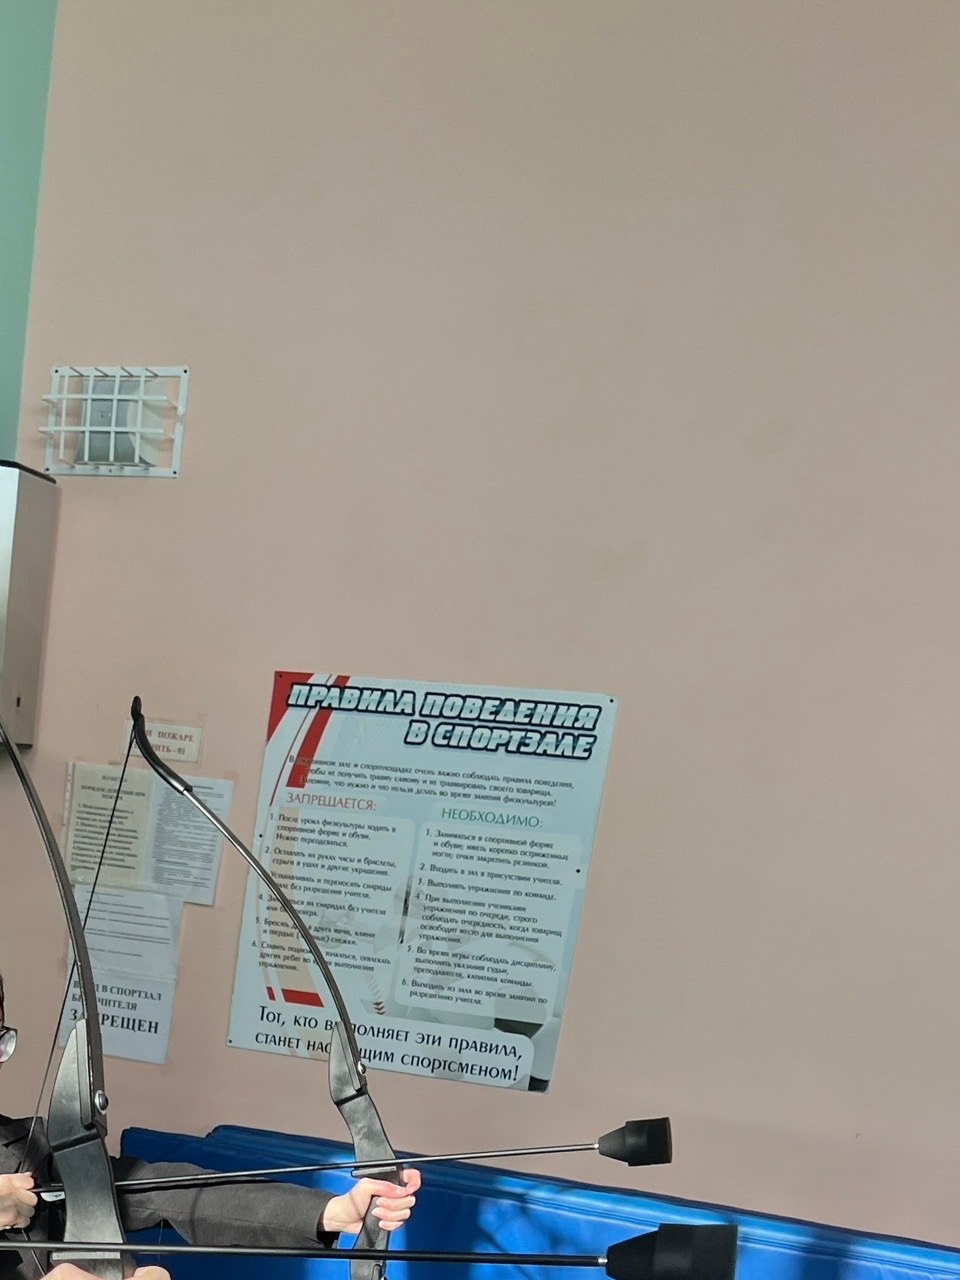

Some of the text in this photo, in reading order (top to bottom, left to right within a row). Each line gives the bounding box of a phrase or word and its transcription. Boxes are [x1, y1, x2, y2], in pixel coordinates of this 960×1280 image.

[287, 683, 603, 730] ПРАВИЛА ПОВЕДЕНИЯ
[158, 731, 193, 742] ПОЖАРЕ
[403, 719, 597, 760] В СПОРТЗАЛЕ
[462, 772, 500, 781] соблюдать
[287, 792, 376, 811] ЗАПРЕЩАЕТСЯ:
[442, 808, 542, 828] НЕОБХОДИМО:
[110, 986, 161, 1001] СПОРТЗАЛ
[98, 998, 137, 1011] ЧИТЕЛЯ
[70, 1009, 159, 1034] ЗРЕЩЕН
